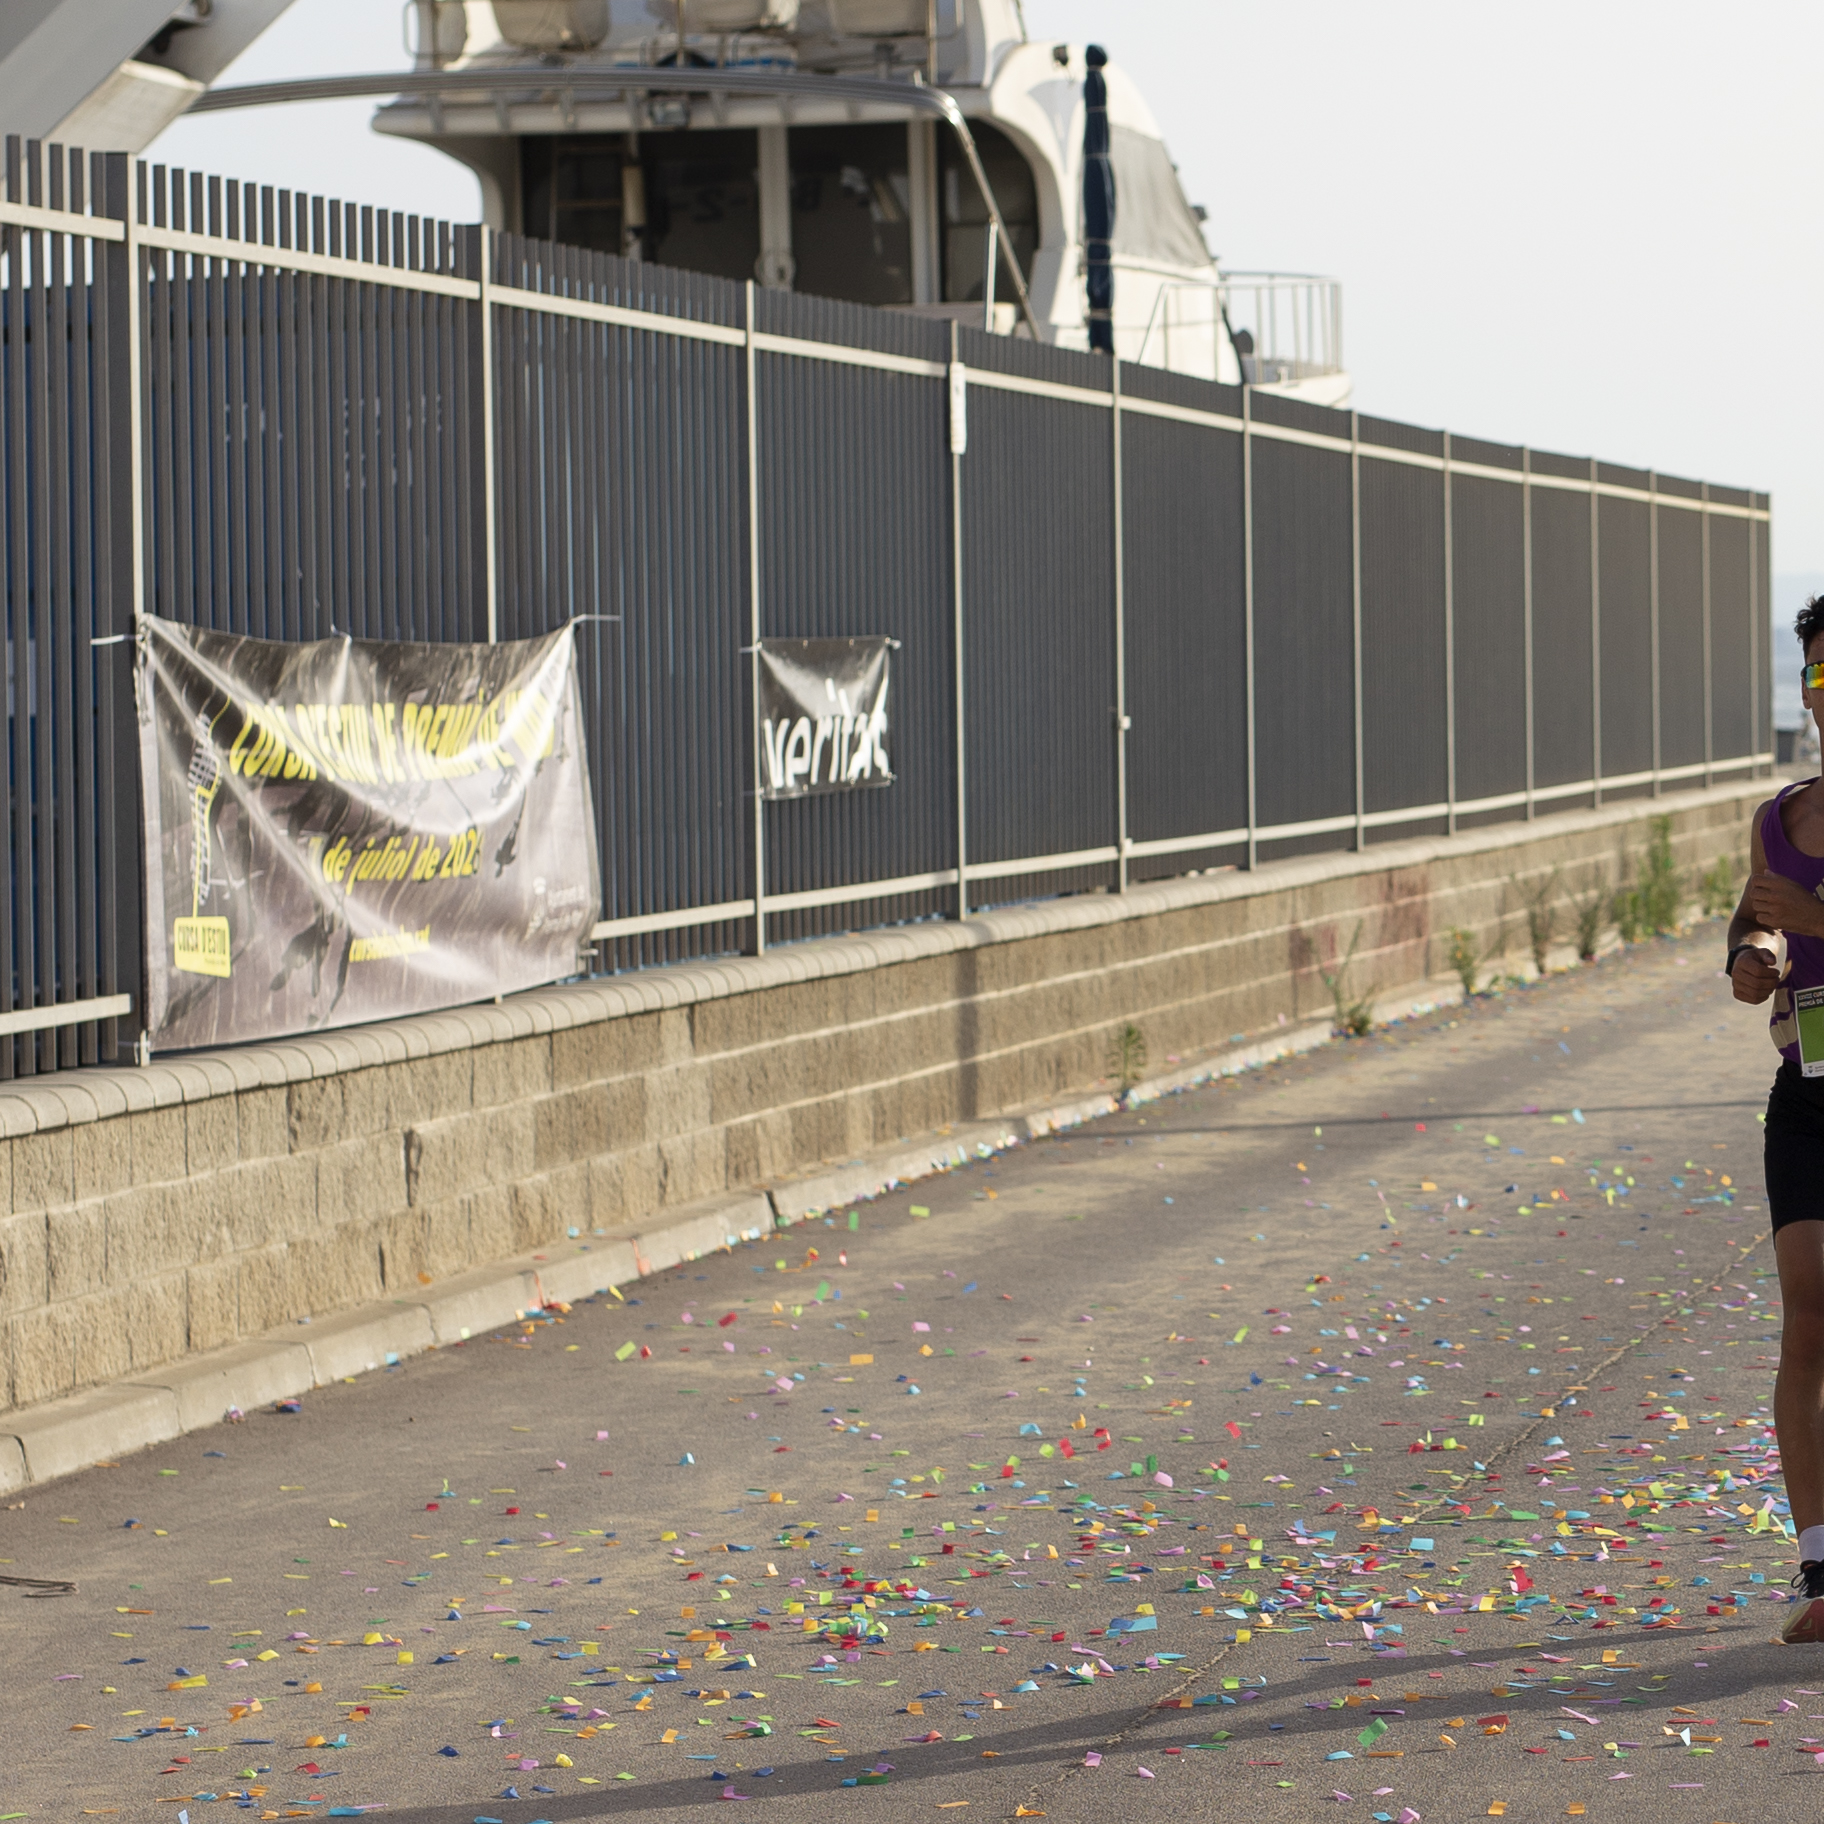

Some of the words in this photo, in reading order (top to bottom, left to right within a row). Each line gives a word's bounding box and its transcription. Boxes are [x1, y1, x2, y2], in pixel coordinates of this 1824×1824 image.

[323, 835, 353, 883] de
[344, 834, 421, 896] juliol
[411, 833, 441, 881] de
